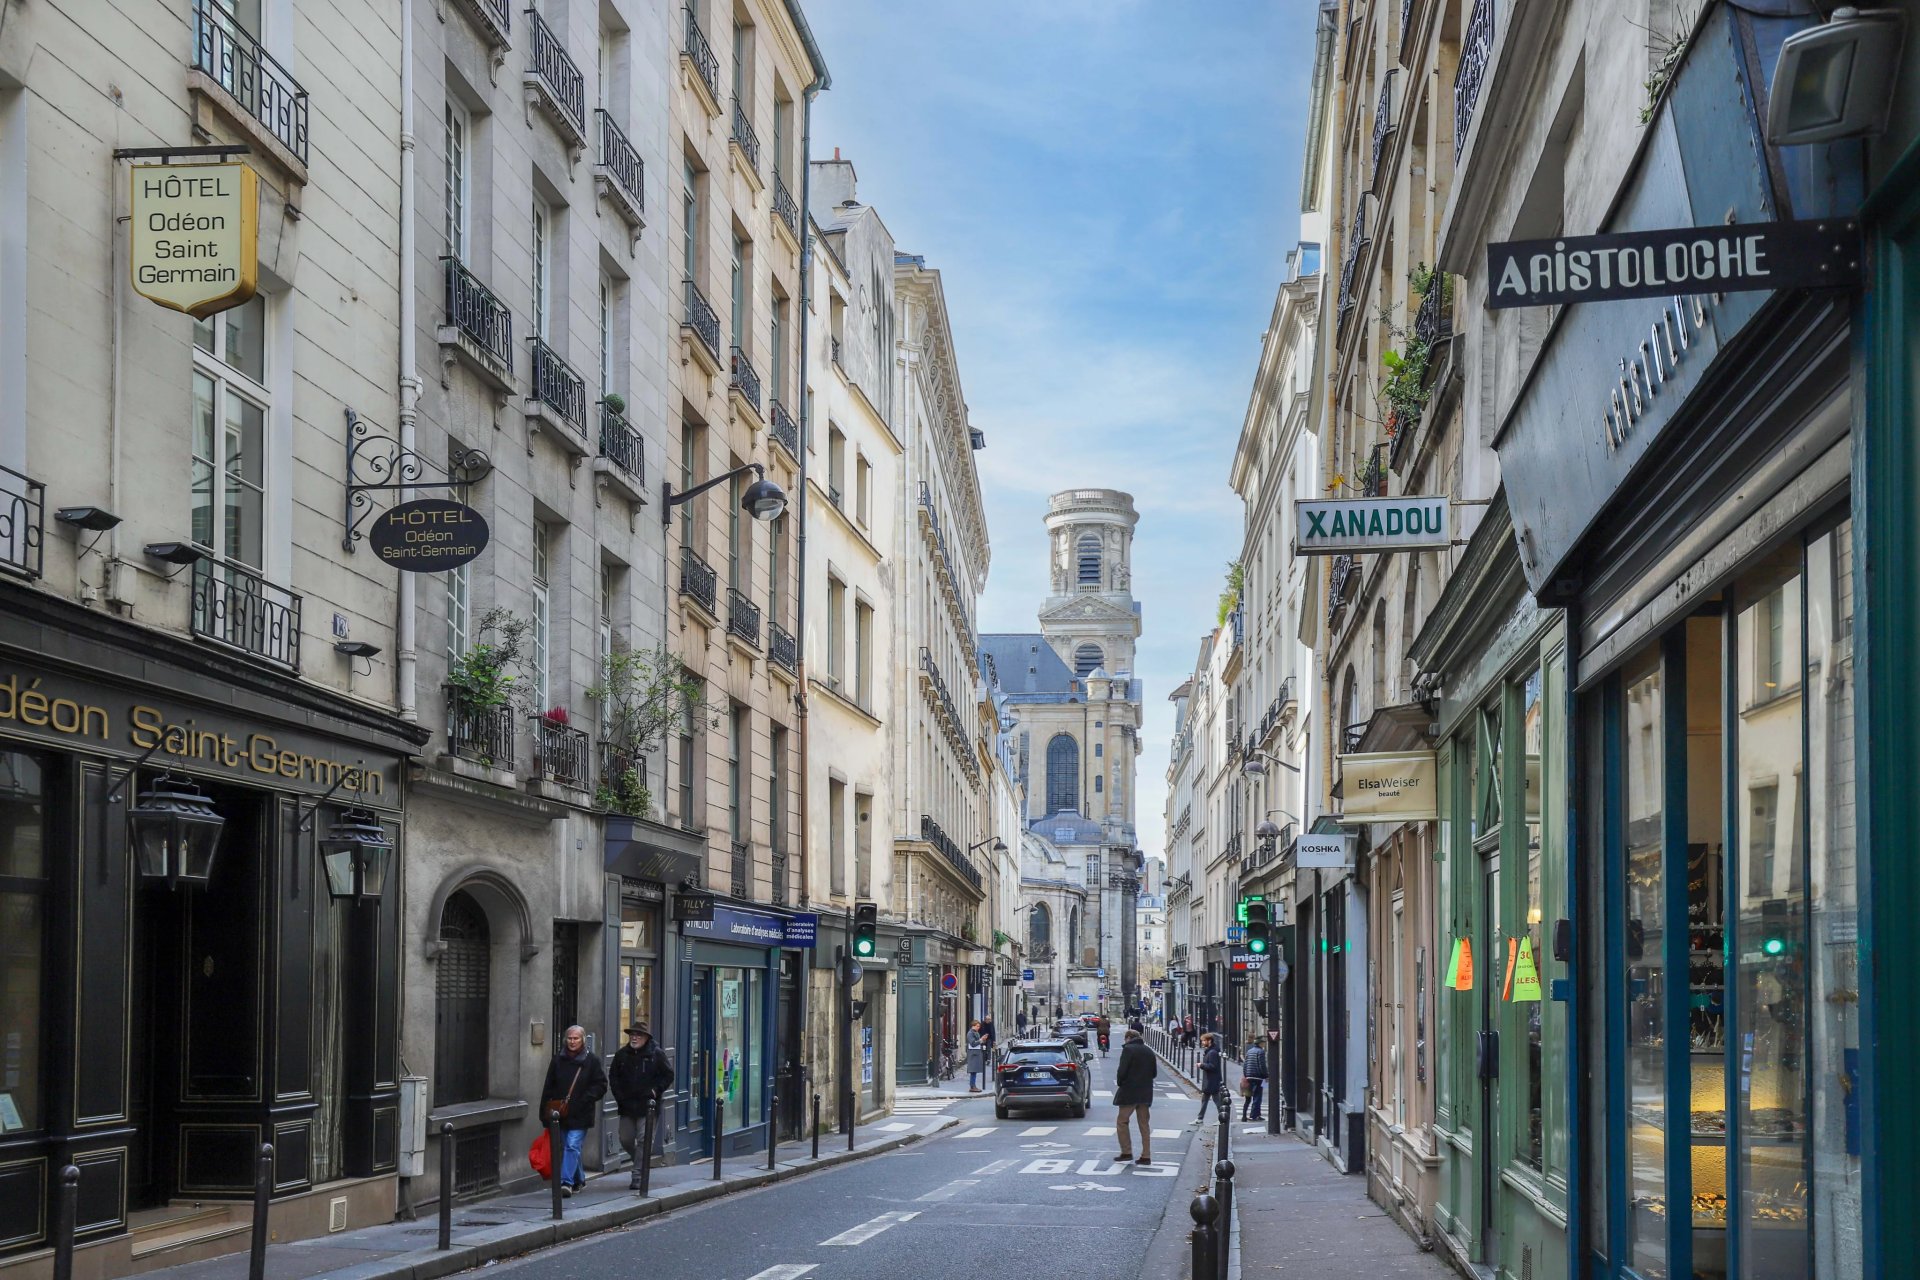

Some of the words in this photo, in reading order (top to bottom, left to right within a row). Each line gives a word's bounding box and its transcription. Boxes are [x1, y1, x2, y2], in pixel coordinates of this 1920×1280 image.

[143, 174, 230, 199] HÔTEL
[148, 211, 225, 232] Odéon
[154, 239, 219, 259] Saint
[138, 264, 236, 286] Germain
[389, 505, 473, 525] HÔTEL
[1305, 505, 1442, 539] XANADOU
[404, 528, 454, 543] Odéon
[382, 544, 476, 559] Saint-Germain
[336, 616, 346, 637] 13
[132, 704, 384, 796] Saint-Germain
[1378, 789, 1400, 798] beauté
[1301, 845, 1341, 853] KOSHKA
[683, 899, 705, 909] TILLY
[1018, 1158, 1181, 1177] BUS
